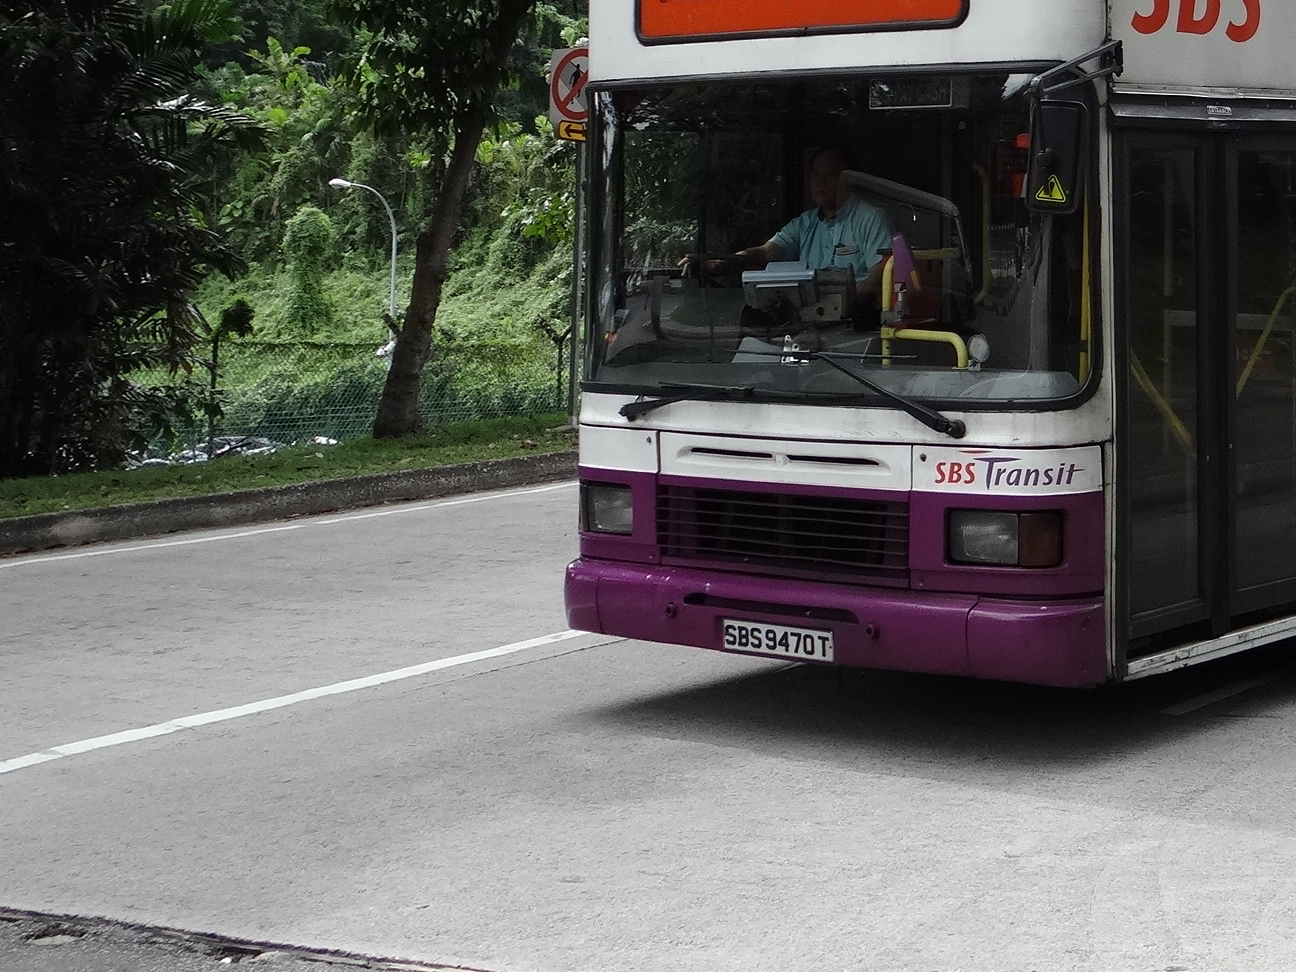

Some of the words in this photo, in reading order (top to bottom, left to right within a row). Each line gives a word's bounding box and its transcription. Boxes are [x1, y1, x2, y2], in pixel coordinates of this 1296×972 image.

[935, 461, 976, 485] SBS
[972, 456, 1086, 491] Transit
[725, 624, 830, 658] SBS9470T
